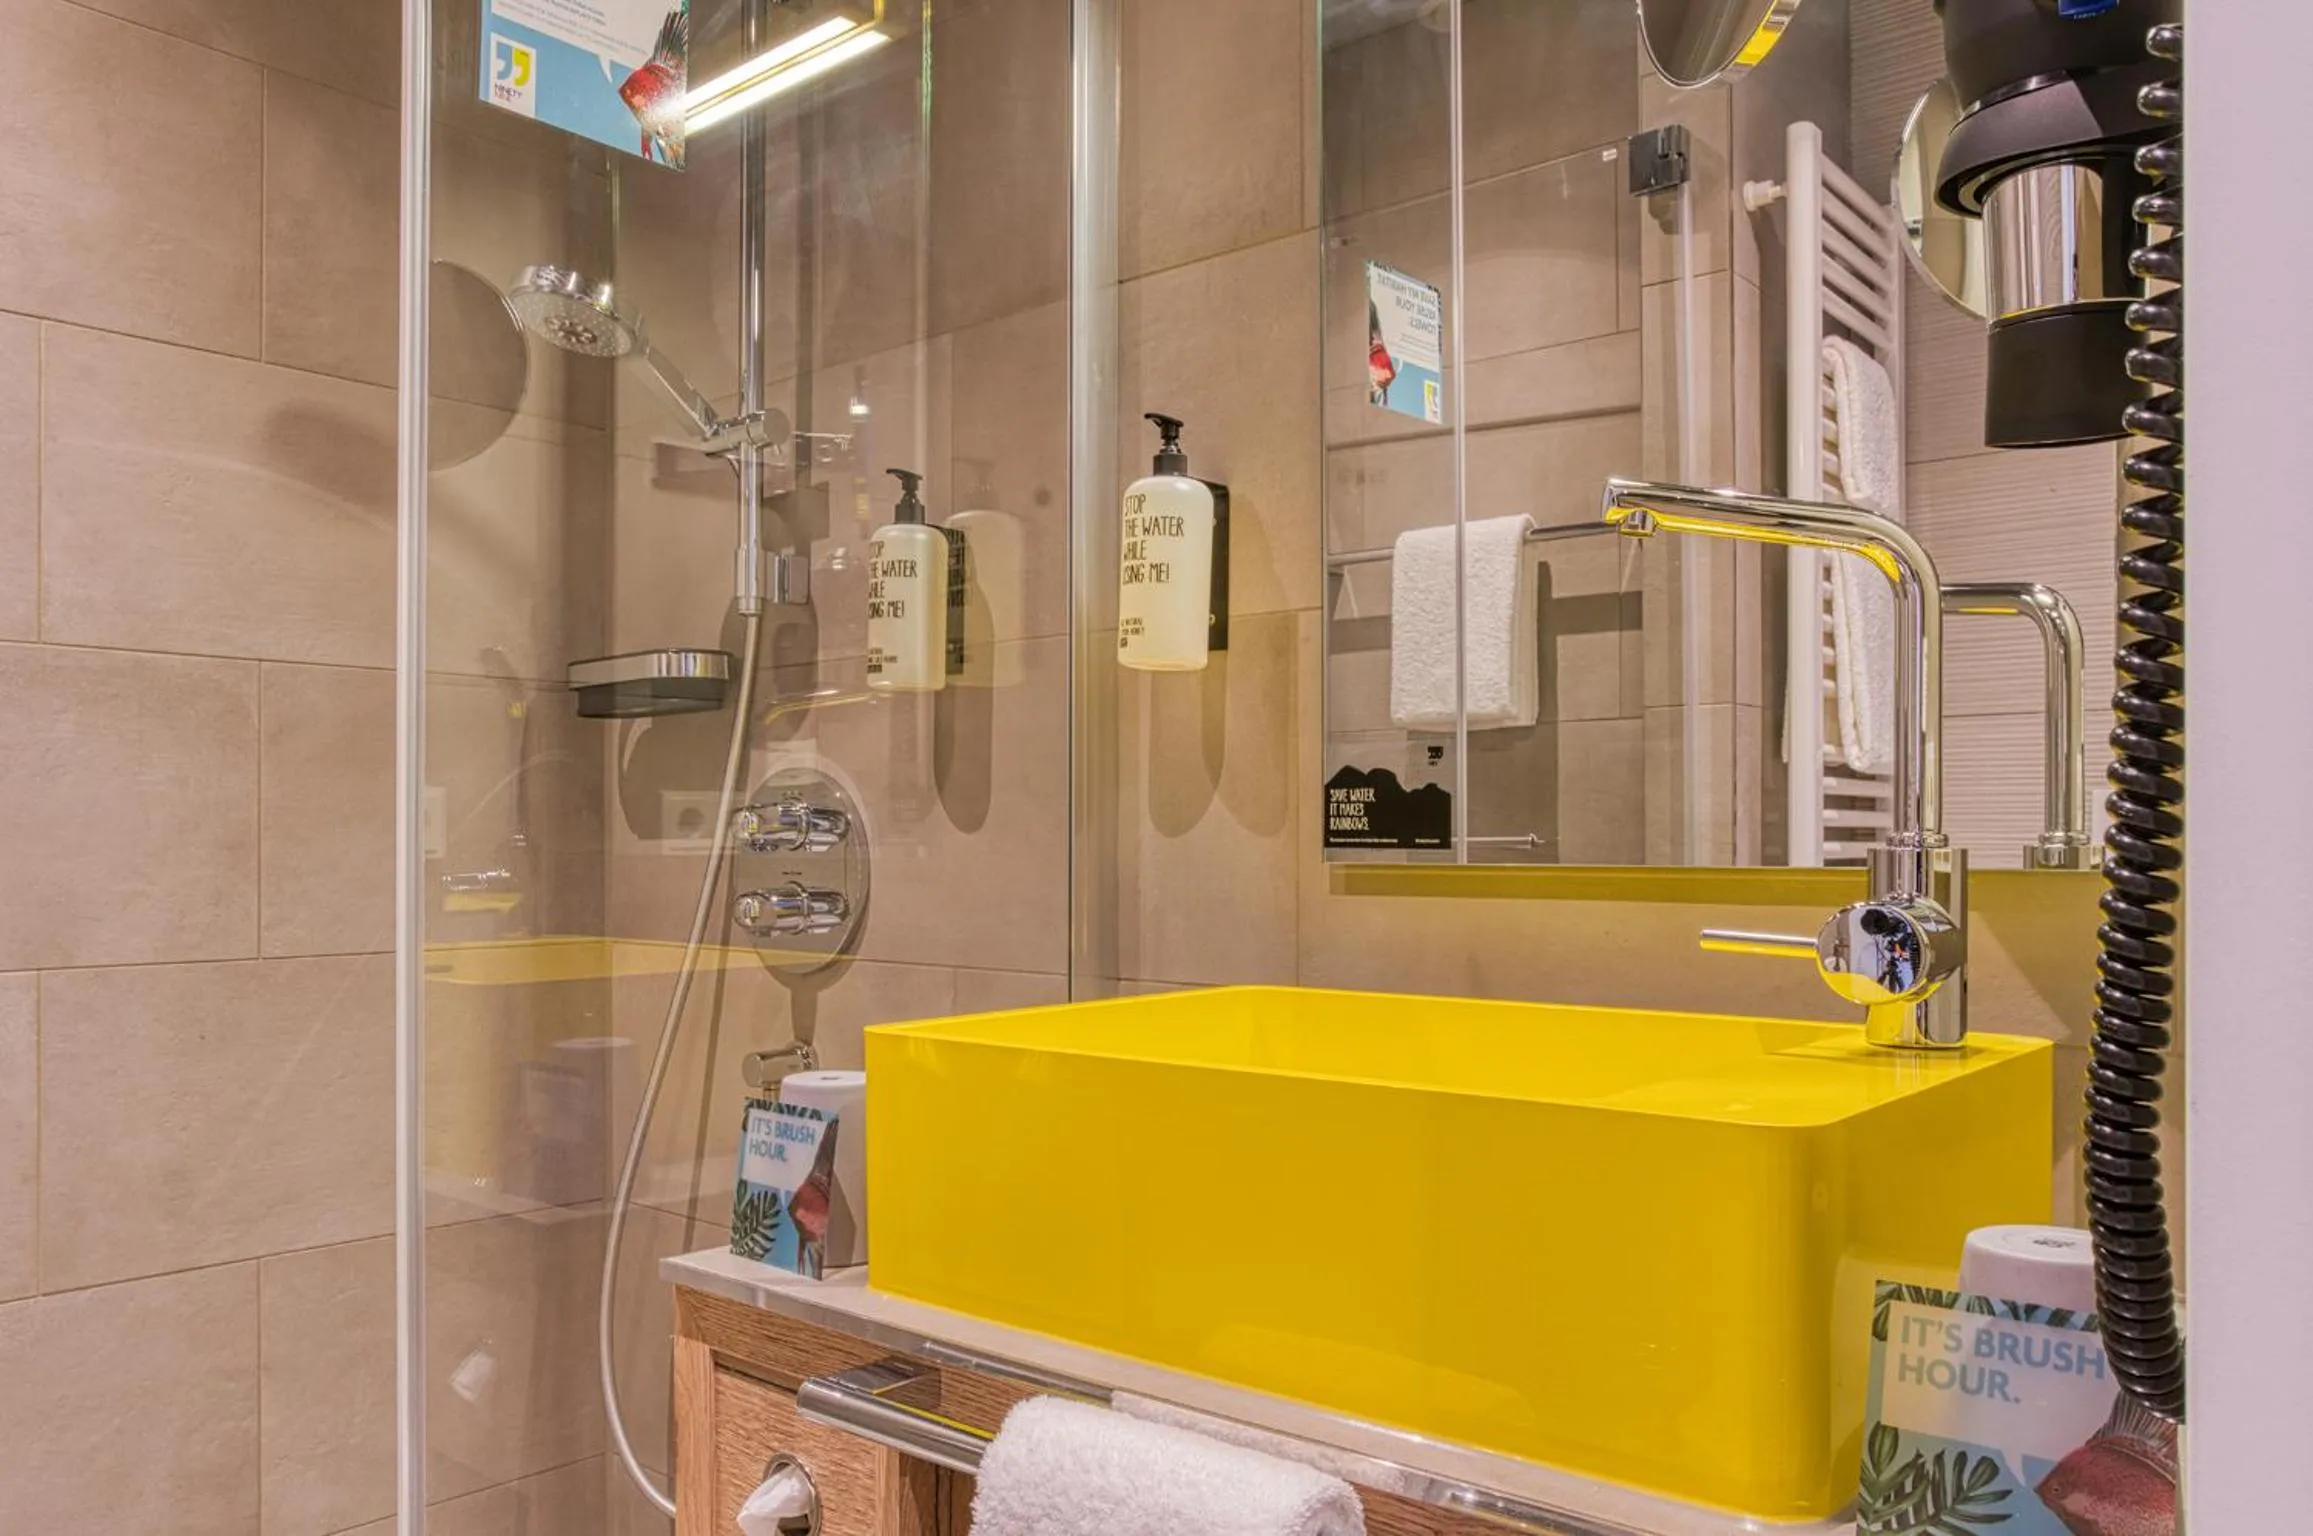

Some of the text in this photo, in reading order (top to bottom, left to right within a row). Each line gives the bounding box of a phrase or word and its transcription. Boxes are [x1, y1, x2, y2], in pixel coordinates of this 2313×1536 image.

[1125, 493, 1147, 517] STOP
[1142, 515, 1185, 537] WATER
[881, 559, 917, 578] WATER
[1149, 562, 1170, 583] ME!
[887, 600, 905, 618] ME!
[1330, 788, 1376, 802] SAVE WATER
[1330, 803, 1364, 816] IT MAKES
[751, 1116, 816, 1147] IT'S BRUSH
[1901, 1316, 2105, 1380] IT'S BRUSH
[1898, 1353, 2021, 1404] HOUR.
